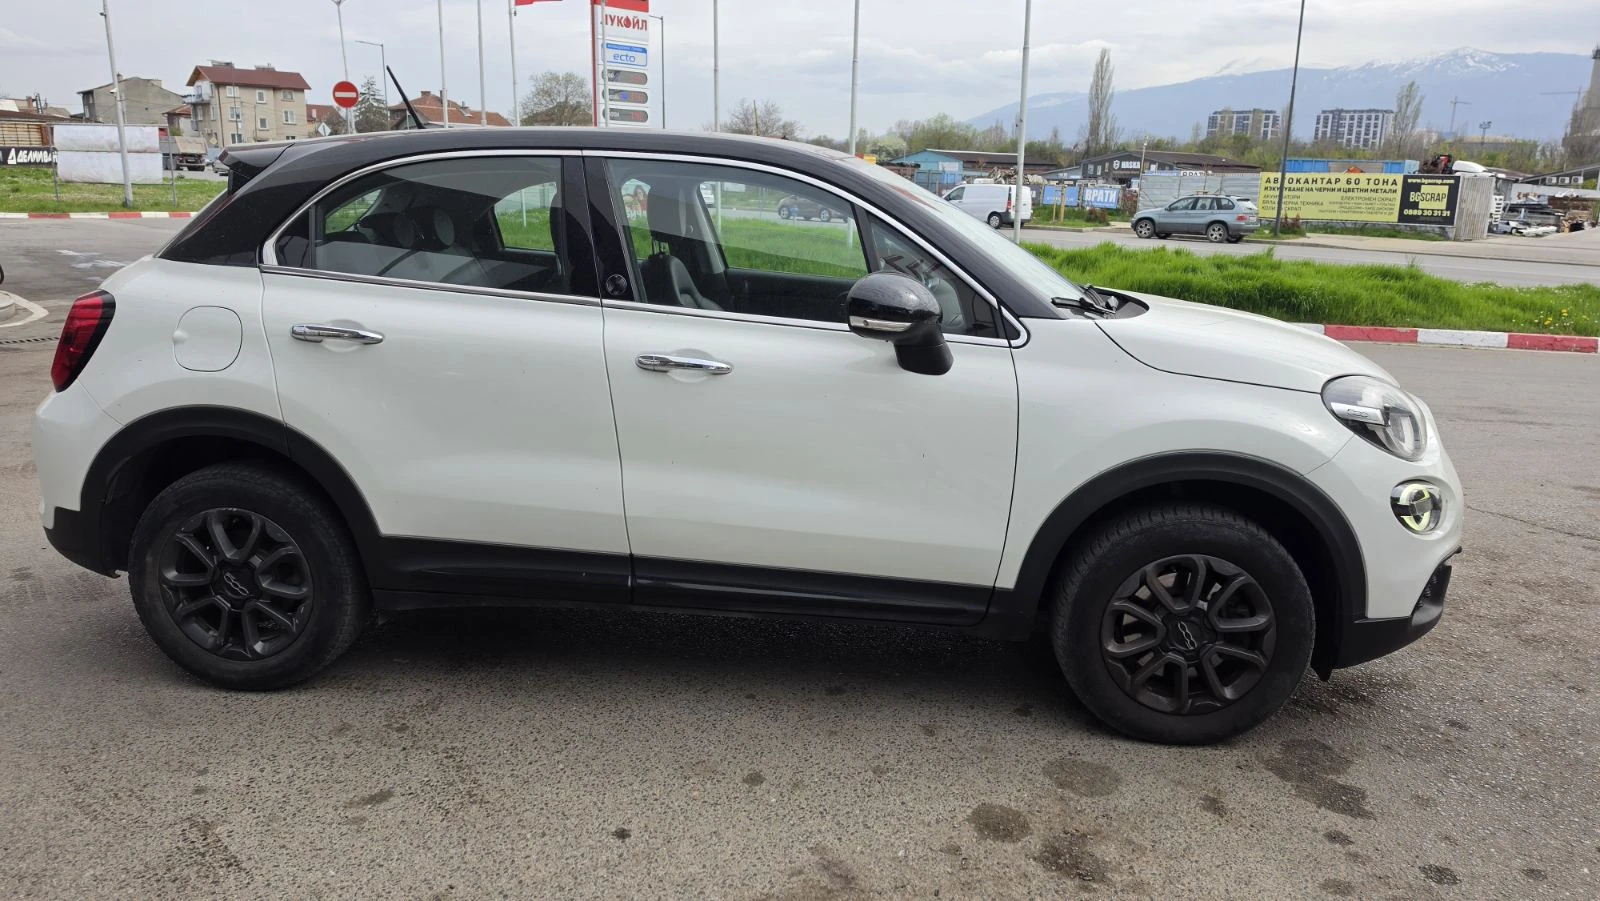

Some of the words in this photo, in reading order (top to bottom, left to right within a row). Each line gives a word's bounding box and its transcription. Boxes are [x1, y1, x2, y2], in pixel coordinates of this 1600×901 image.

[613, 53, 636, 63] ecto
[1265, 177, 1341, 186] АВОКАНТАР
[1346, 177, 1361, 186] 60
[1366, 178, 1398, 186] ТОНА
[1085, 188, 1117, 202] ВРАТИ
[1410, 191, 1447, 203] BGSCRAP
